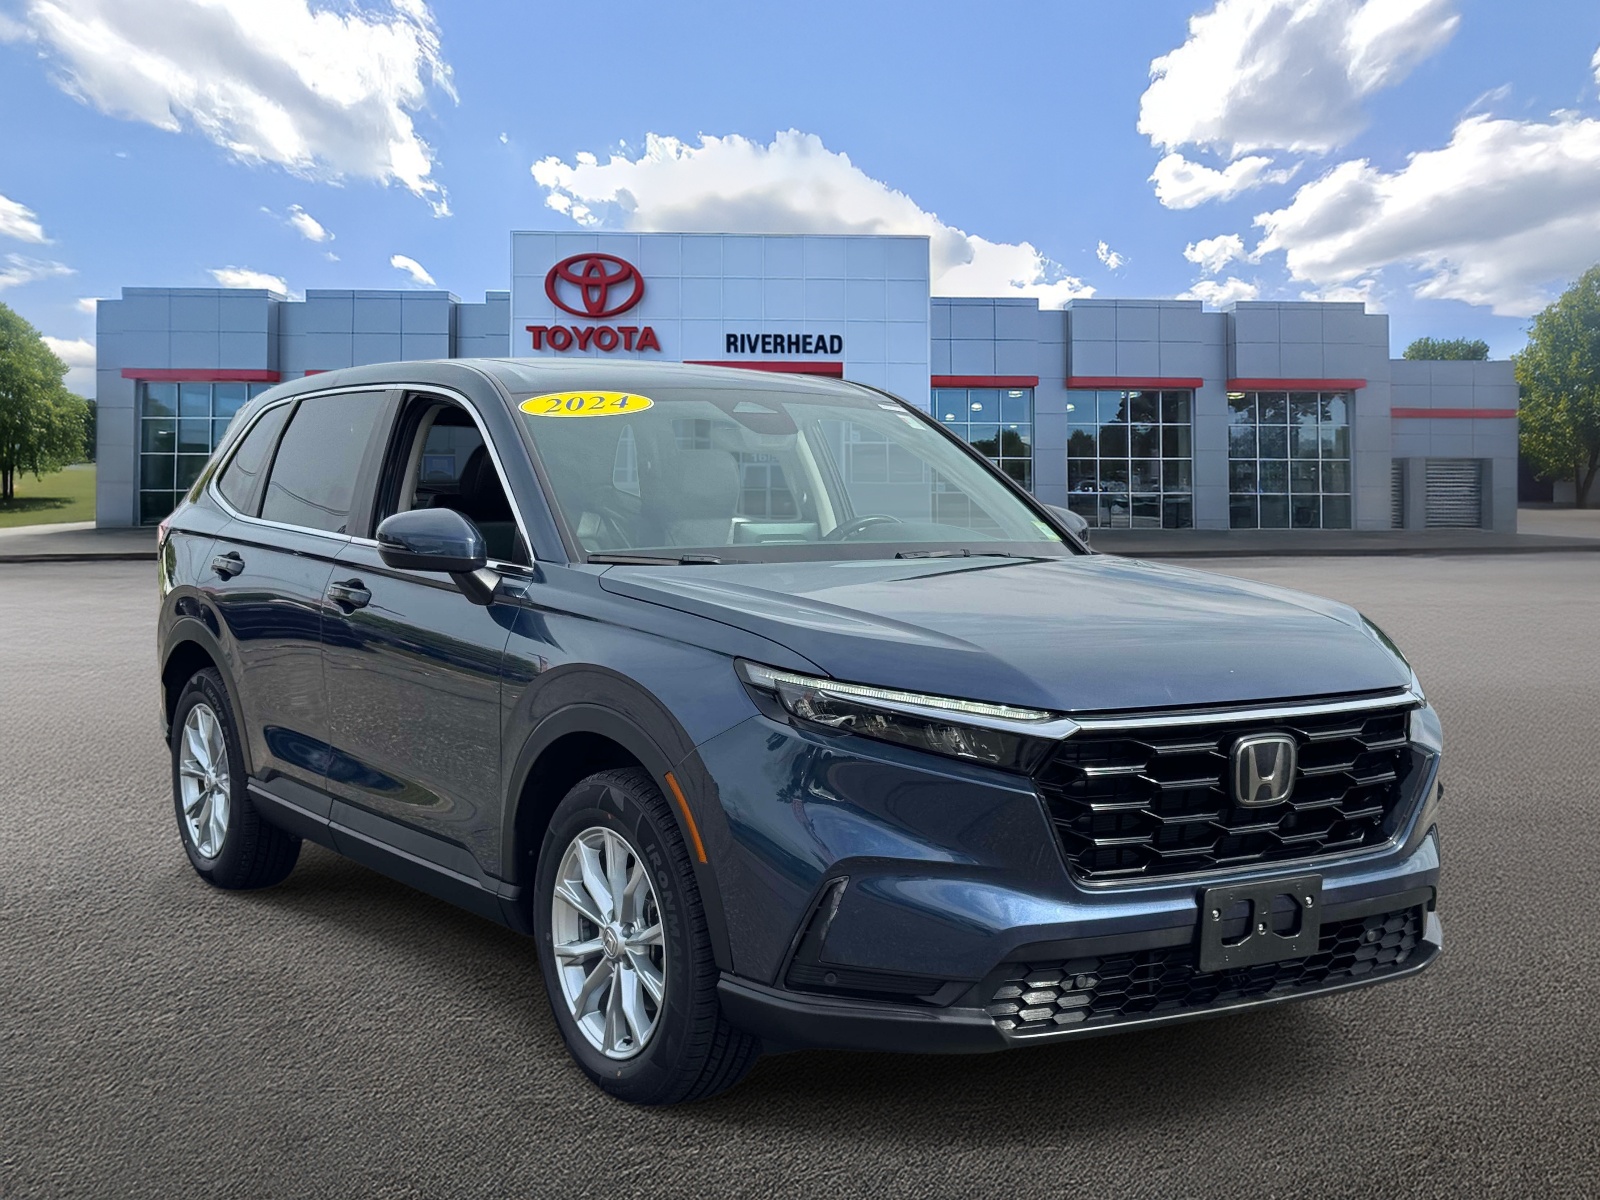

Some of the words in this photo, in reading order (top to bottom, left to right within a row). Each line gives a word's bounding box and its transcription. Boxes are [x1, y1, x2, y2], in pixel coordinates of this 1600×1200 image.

[526, 325, 661, 352] TOYOTA
[725, 333, 843, 355] RIVERHEAD
[544, 395, 629, 414] 2024
